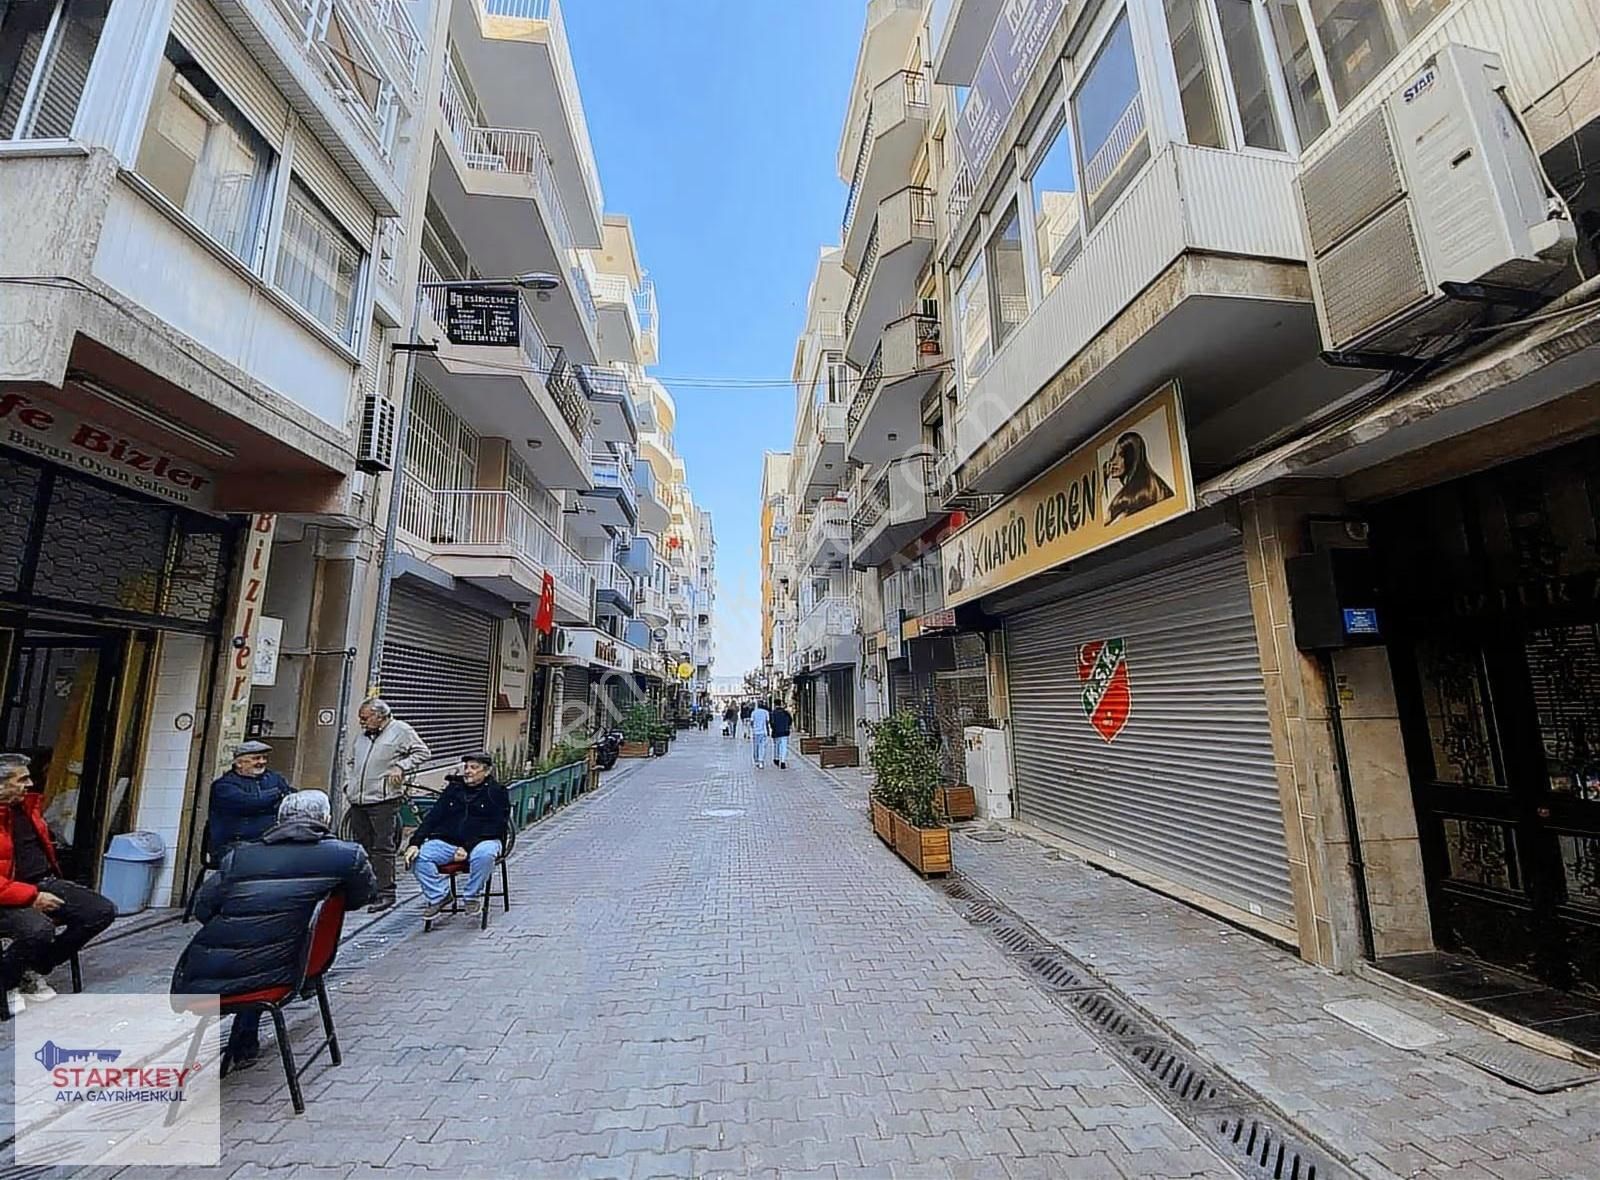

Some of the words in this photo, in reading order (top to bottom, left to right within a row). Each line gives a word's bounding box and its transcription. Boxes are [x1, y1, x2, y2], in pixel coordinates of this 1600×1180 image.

[1402, 70, 1435, 103] STAR
[7, 428, 73, 461] Bayan
[79, 455, 129, 482] Oyun
[134, 474, 189, 503] Salonu
[71, 423, 210, 491] Bizler
[1034, 470, 1097, 548] CEREN
